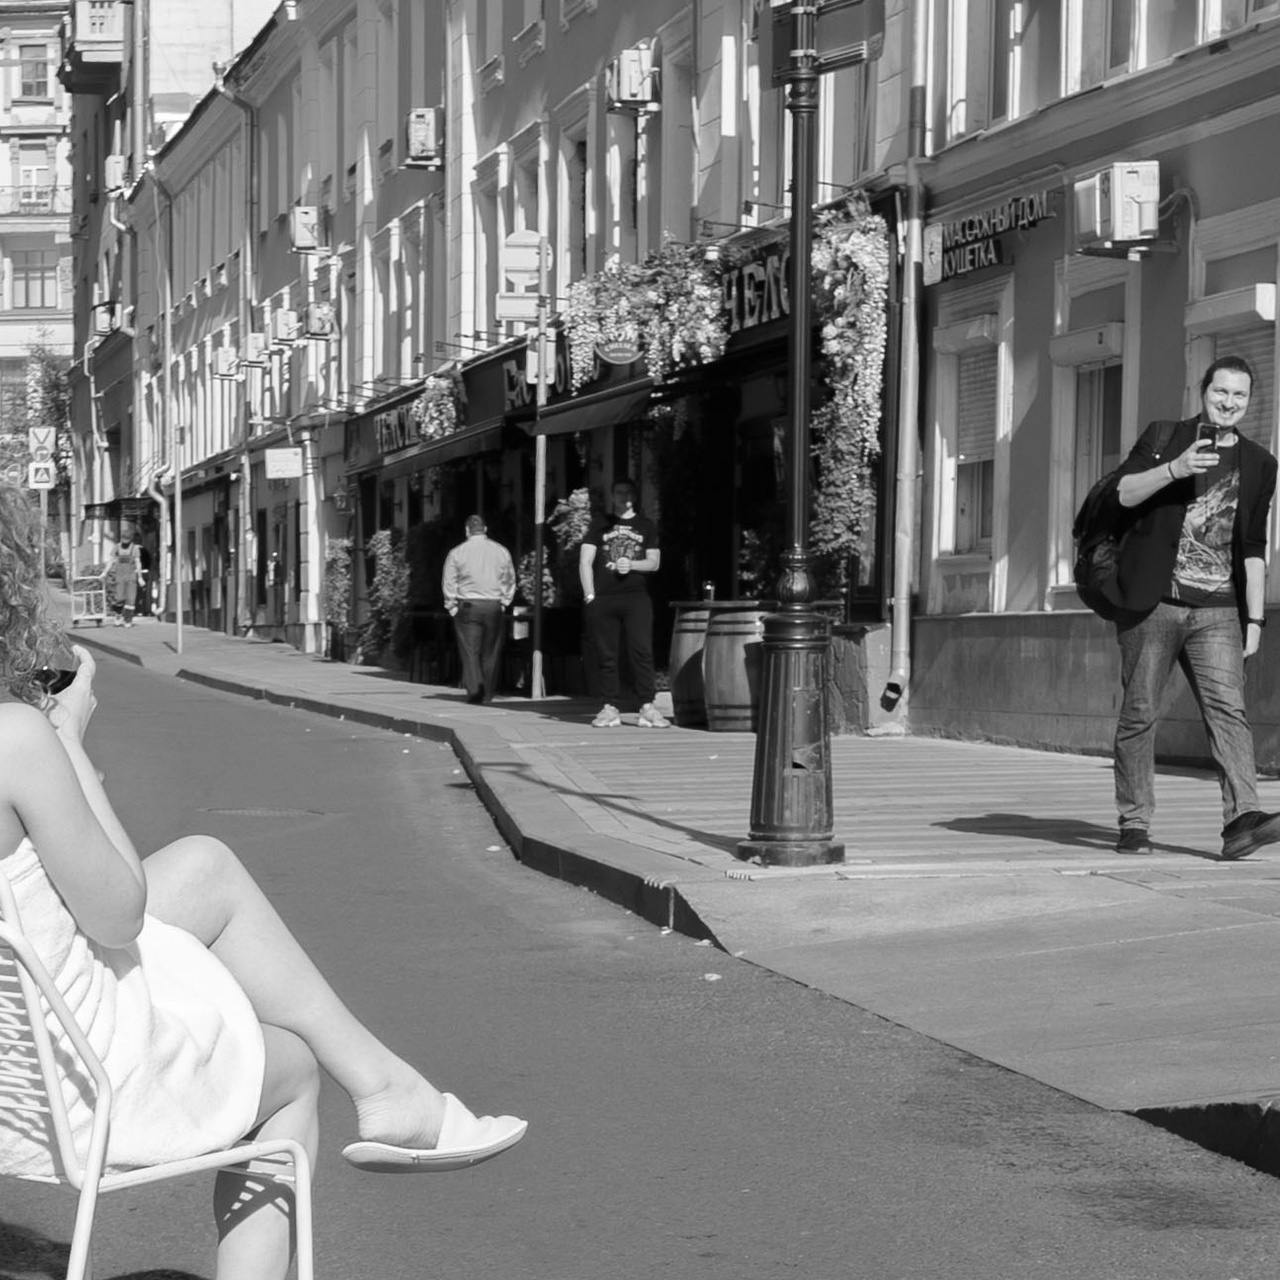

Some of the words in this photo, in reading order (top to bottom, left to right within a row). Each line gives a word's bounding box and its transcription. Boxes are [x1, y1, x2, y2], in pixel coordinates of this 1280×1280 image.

[944, 198, 1016, 248] МАССАЖНЫЙ
[1017, 190, 1048, 228] ДОМ
[944, 239, 998, 278] КУШЕТКА
